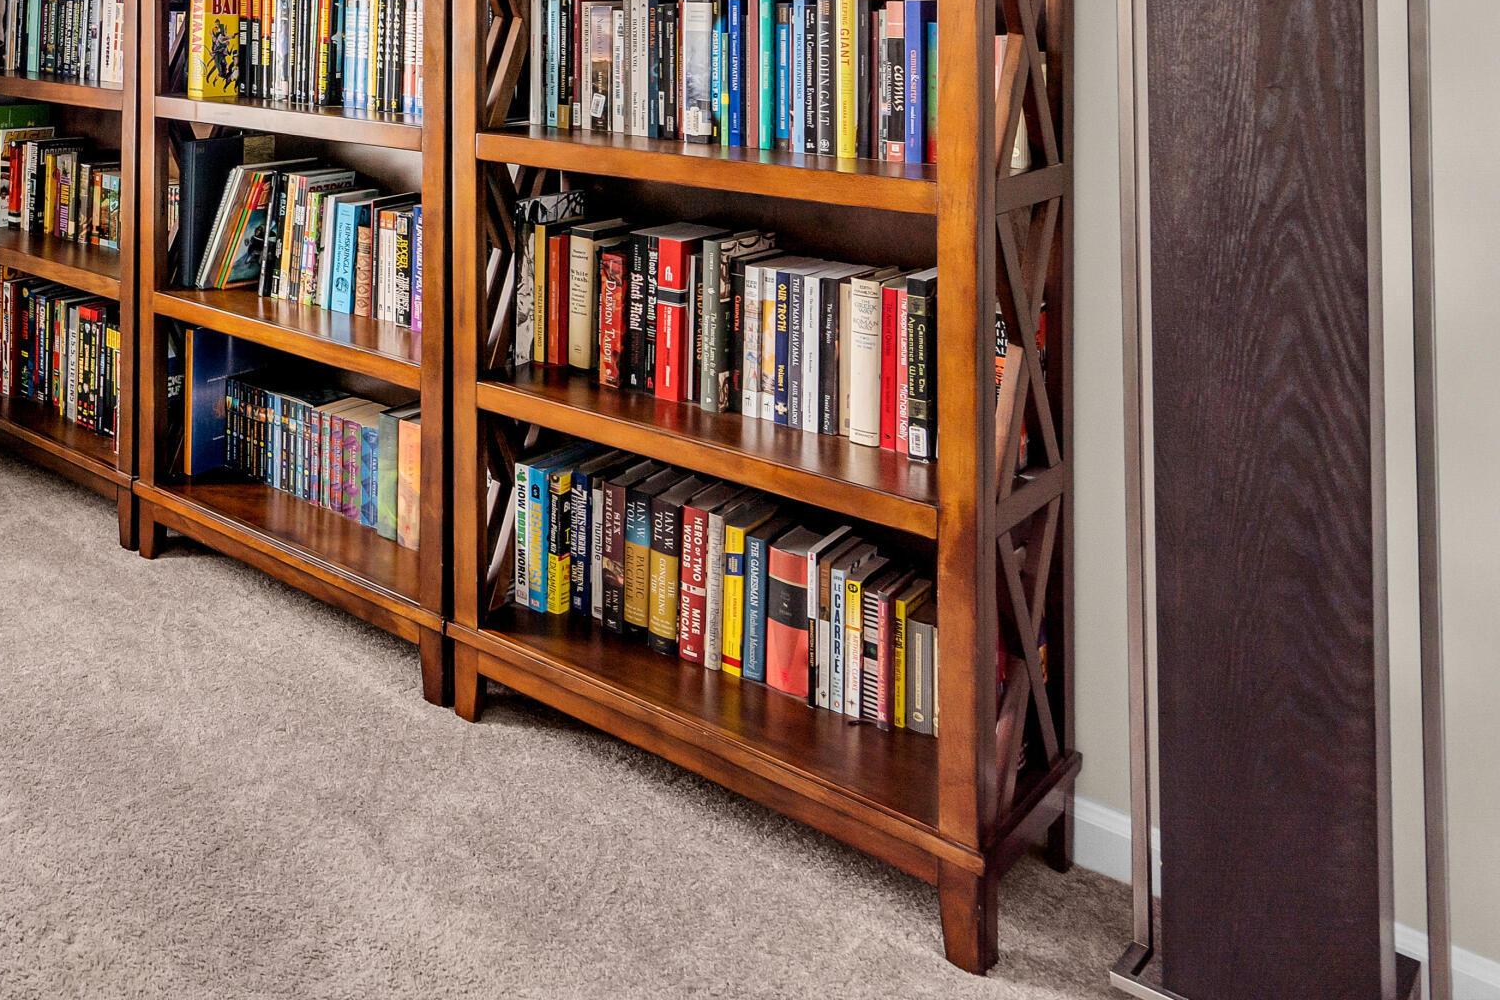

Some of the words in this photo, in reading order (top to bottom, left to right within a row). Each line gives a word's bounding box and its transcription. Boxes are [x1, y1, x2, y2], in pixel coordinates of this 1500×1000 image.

[819, 29, 829, 51] AM
[840, 28, 850, 66] GIANT
[731, 57, 739, 90] LEVIATHAN
[805, 41, 814, 86] Consciousness
[819, 53, 829, 87] JOHN
[893, 65, 904, 111] camus
[804, 88, 815, 128] Everywhere?
[819, 91, 829, 126] GALT
[777, 283, 788, 301] OUR
[791, 279, 800, 291] THE
[604, 280, 616, 325] DAEMON
[777, 304, 787, 331] TROTH
[604, 329, 615, 363] TAROT
[791, 331, 800, 366] HAVAMAL
[898, 384, 908, 413] Michael
[898, 416, 908, 440] Kelly
[517, 484, 526, 509] HOW
[605, 489, 613, 553] FRIGATES
[613, 512, 621, 535] SIX
[626, 502, 636, 531] TOLL
[635, 502, 646, 524] IAN
[653, 512, 663, 541] TOLL
[664, 512, 675, 534] IAN
[593, 522, 604, 560] humble
[635, 526, 646, 539] W.
[664, 536, 674, 549] W.
[693, 517, 703, 545] HERO
[682, 524, 692, 568] WORLDS
[750, 542, 759, 556] THE
[517, 549, 526, 585] WORKS
[635, 555, 645, 599] PACIFIC
[692, 558, 702, 581] TWO
[657, 558, 667, 615] CONQUERING
[750, 559, 759, 607] GAMESMAN
[680, 596, 691, 640] DUNCAN
[691, 608, 701, 635] MIKE
[749, 609, 759, 636] Michael
